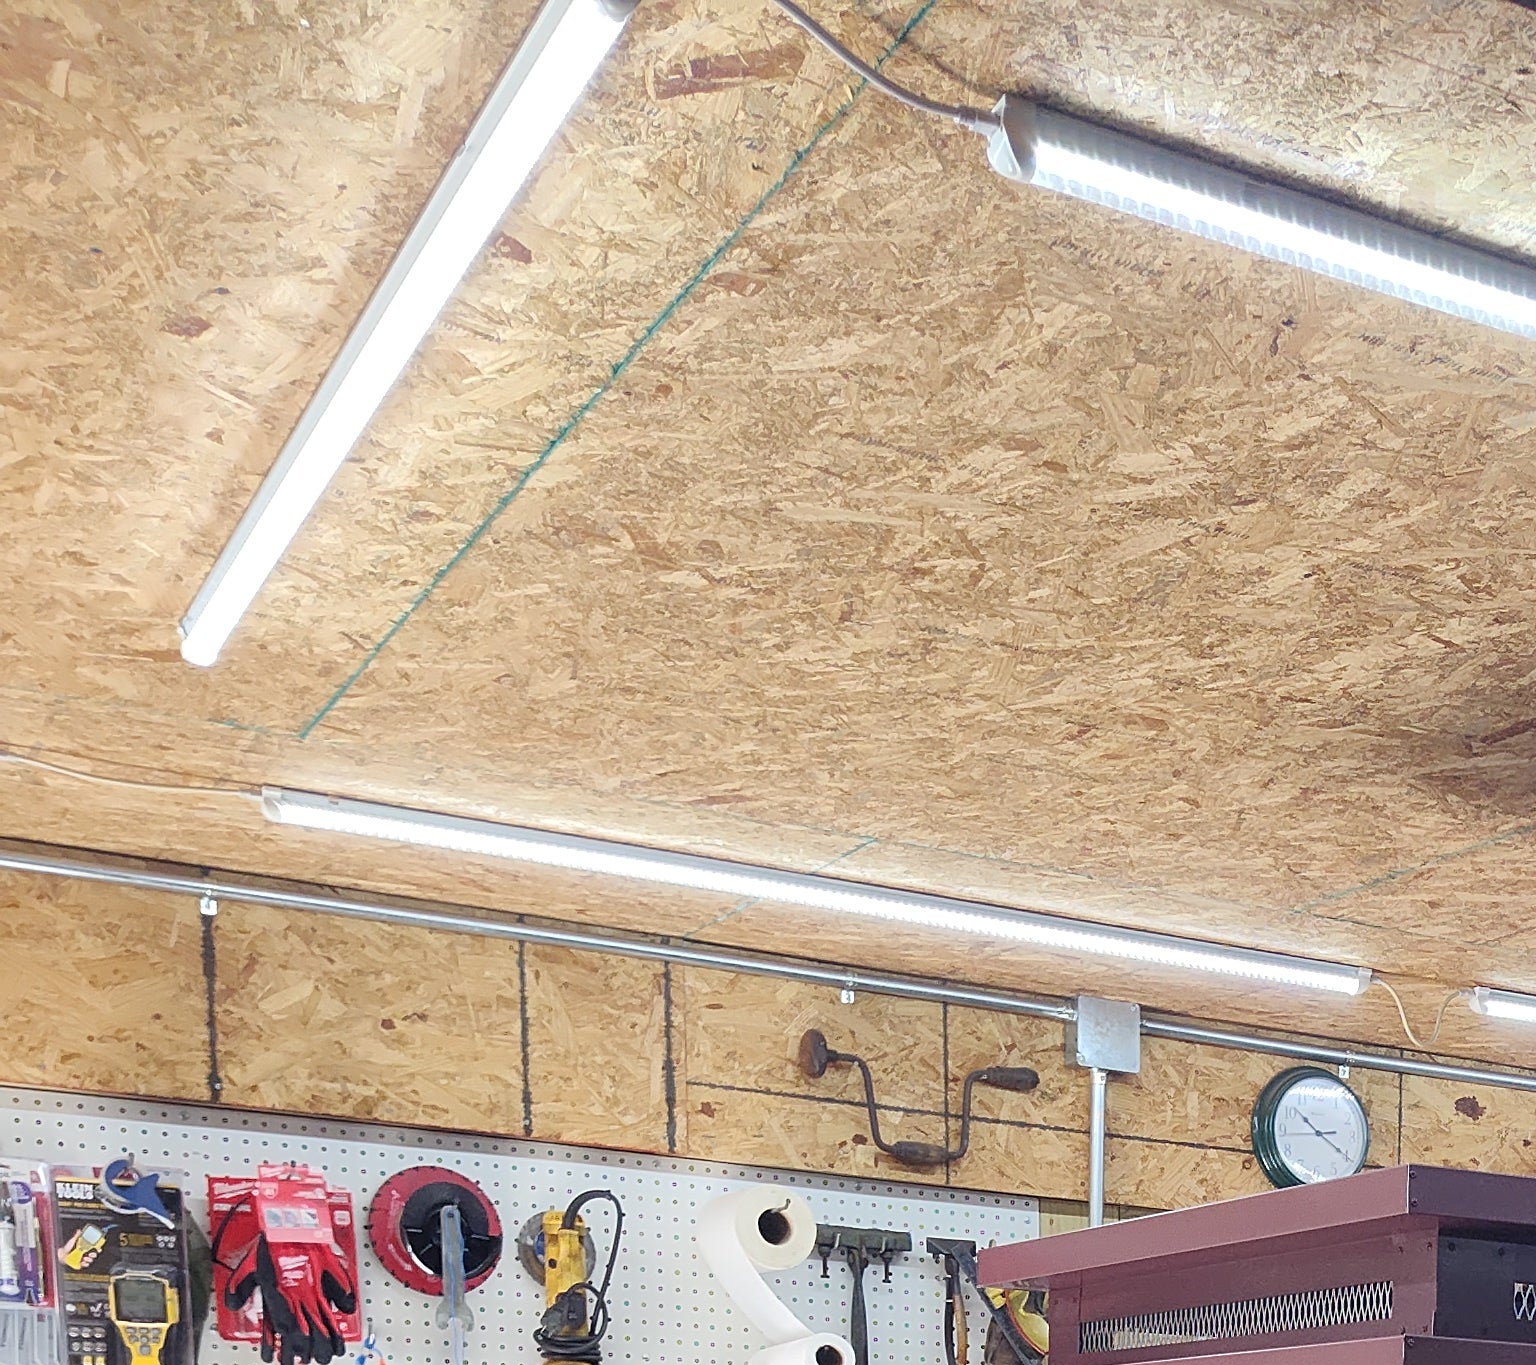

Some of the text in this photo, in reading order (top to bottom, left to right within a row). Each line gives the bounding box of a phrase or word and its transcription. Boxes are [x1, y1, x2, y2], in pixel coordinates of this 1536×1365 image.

[1284, 1106, 1297, 1119] 10
[1344, 1111, 1351, 1126] 2
[1279, 1123, 1287, 1137] 9
[1284, 1143, 1291, 1157] 8
